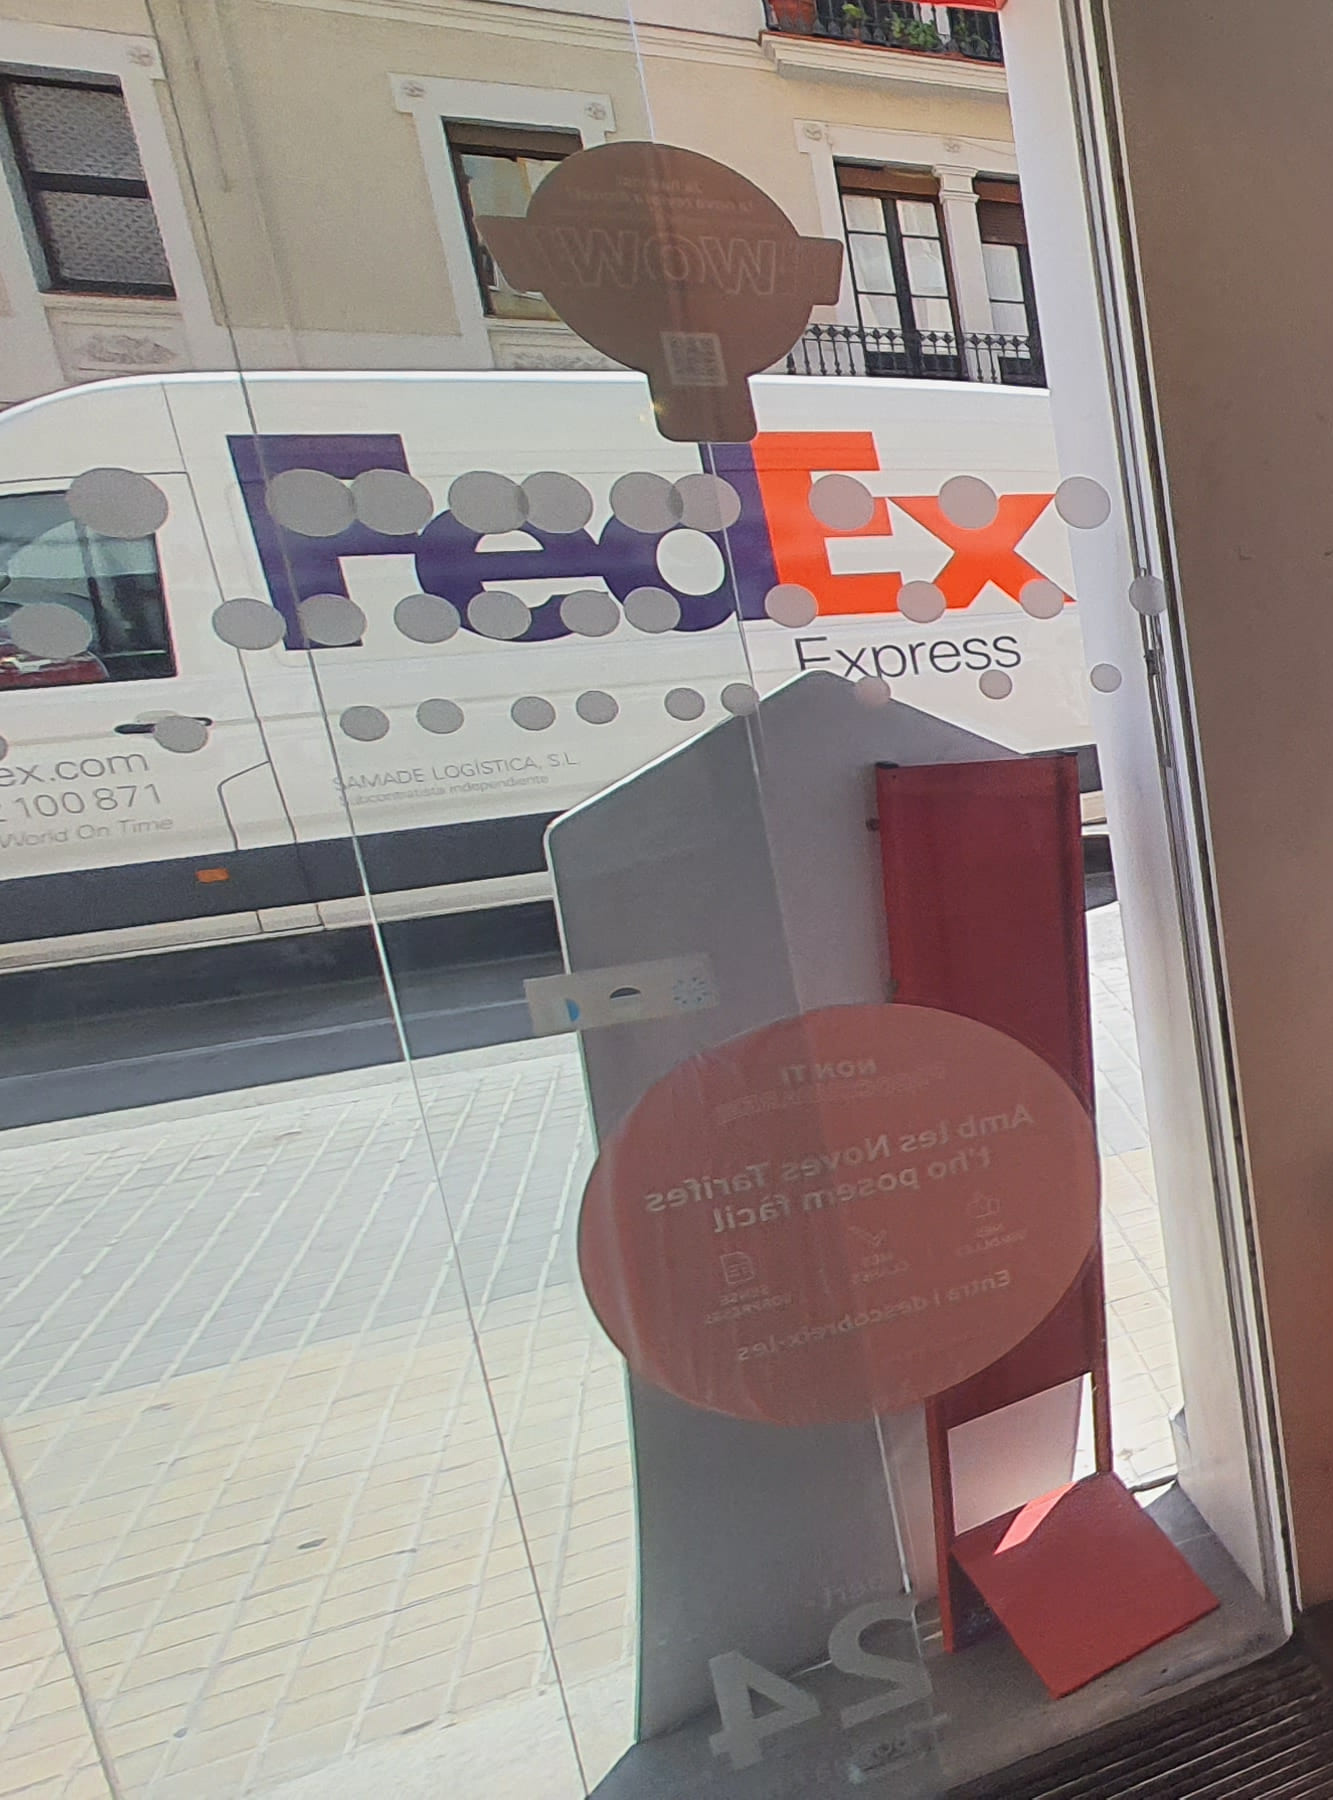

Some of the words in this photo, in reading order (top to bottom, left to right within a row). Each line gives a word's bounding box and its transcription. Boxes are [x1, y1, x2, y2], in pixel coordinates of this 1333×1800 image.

[226, 430, 1078, 651] FedEx
[794, 635, 1023, 680] Express
[332, 768, 425, 792] SAMADE
[15, 791, 86, 819] 100
[93, 783, 162, 811] 871
[77, 824, 110, 840] On
[119, 818, 174, 835] Time
